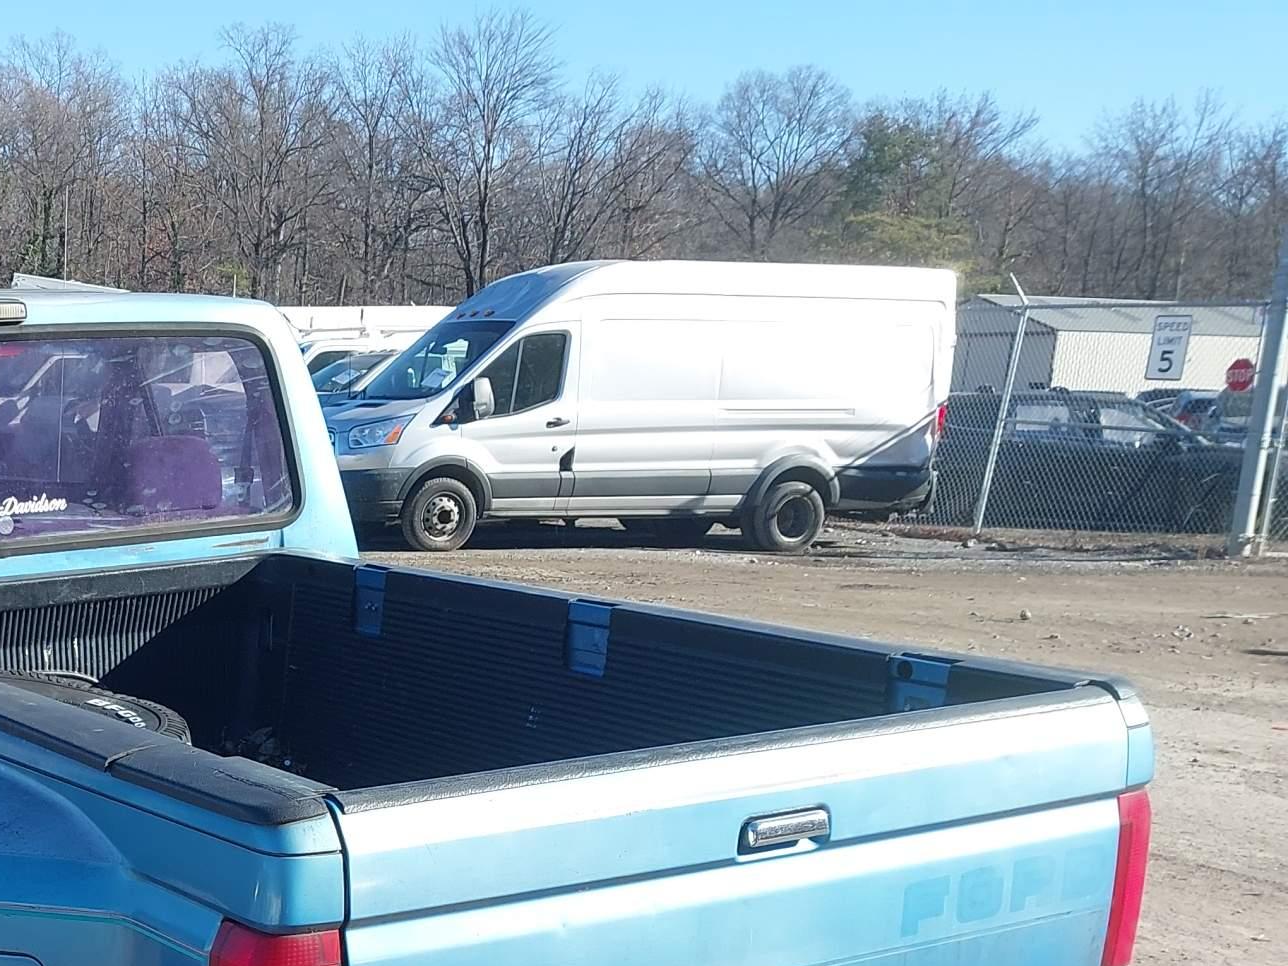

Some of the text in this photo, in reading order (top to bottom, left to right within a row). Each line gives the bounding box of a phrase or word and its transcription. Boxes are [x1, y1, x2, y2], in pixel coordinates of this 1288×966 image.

[1157, 321, 1189, 331] SPEED
[1157, 335, 1183, 345] LIMIT
[1157, 350, 1173, 373] 5
[1226, 368, 1254, 382] STOP
